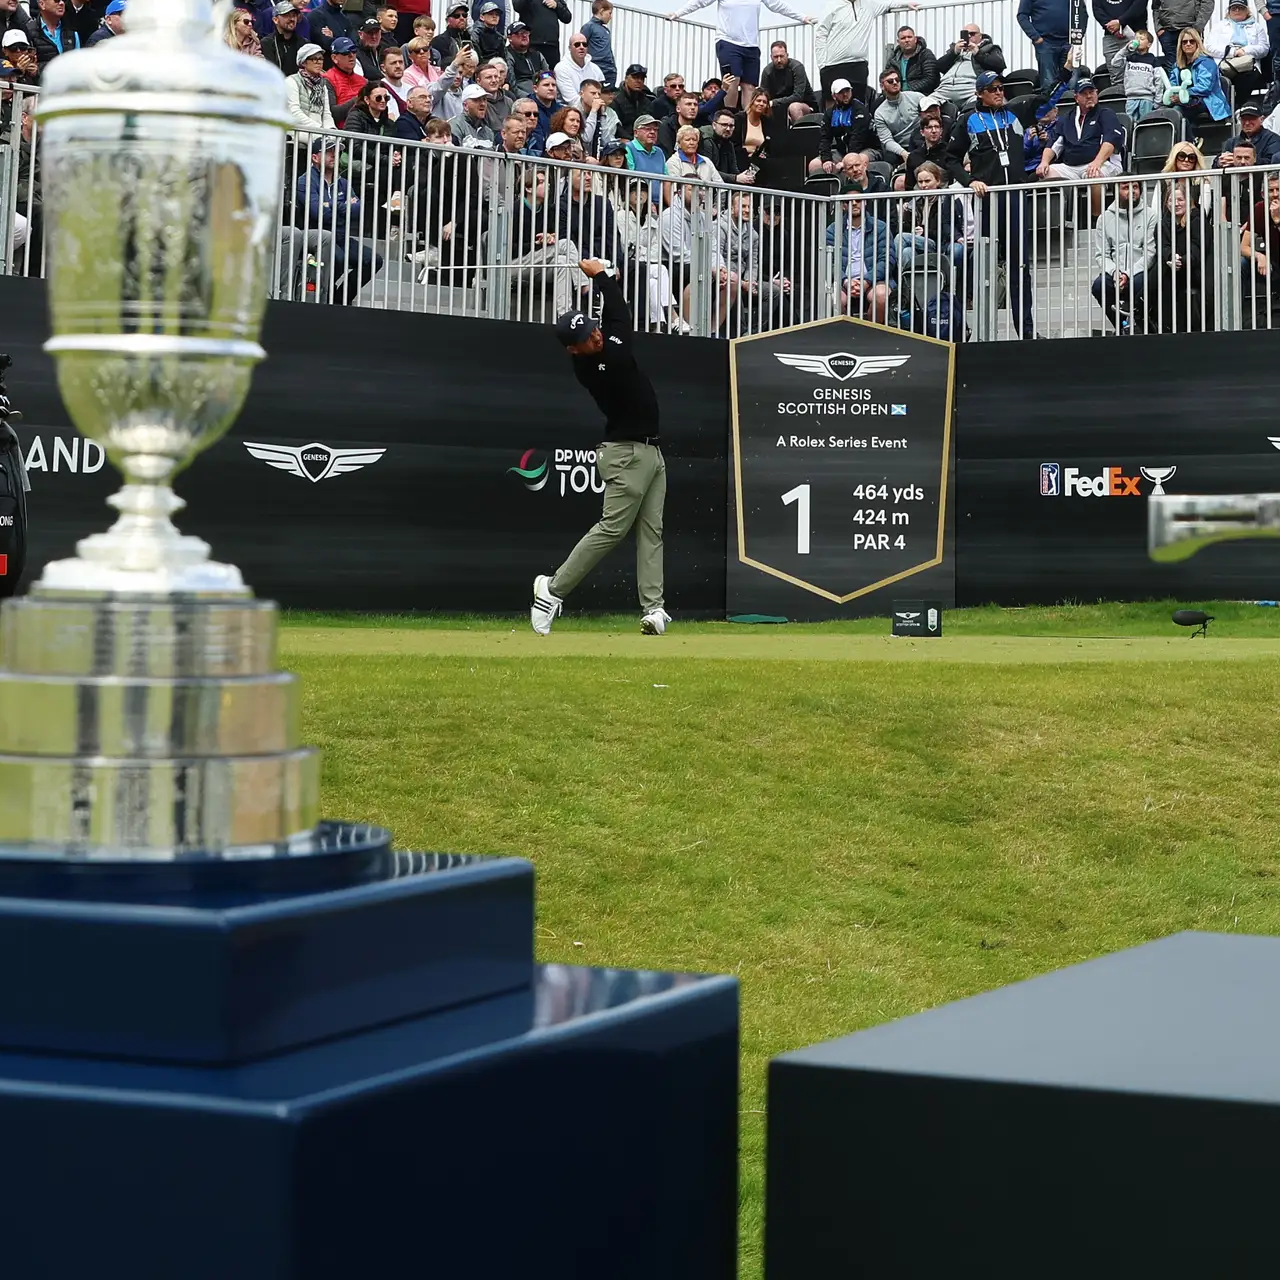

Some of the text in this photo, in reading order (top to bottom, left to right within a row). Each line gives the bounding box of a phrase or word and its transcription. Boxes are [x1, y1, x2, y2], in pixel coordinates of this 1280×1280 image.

[813, 388, 872, 400] GENESIS
[777, 403, 888, 415] SCOTTISH OPEN
[776, 435, 908, 448] A Rolex Series Event
[303, 453, 328, 462] GENESIS
[554, 449, 597, 464] DP WO
[1064, 466, 1142, 497] FedEx
[853, 483, 924, 504] 464 yds
[780, 483, 810, 554] 1
[853, 509, 909, 525] 424 m
[853, 534, 906, 550] PAR 4
